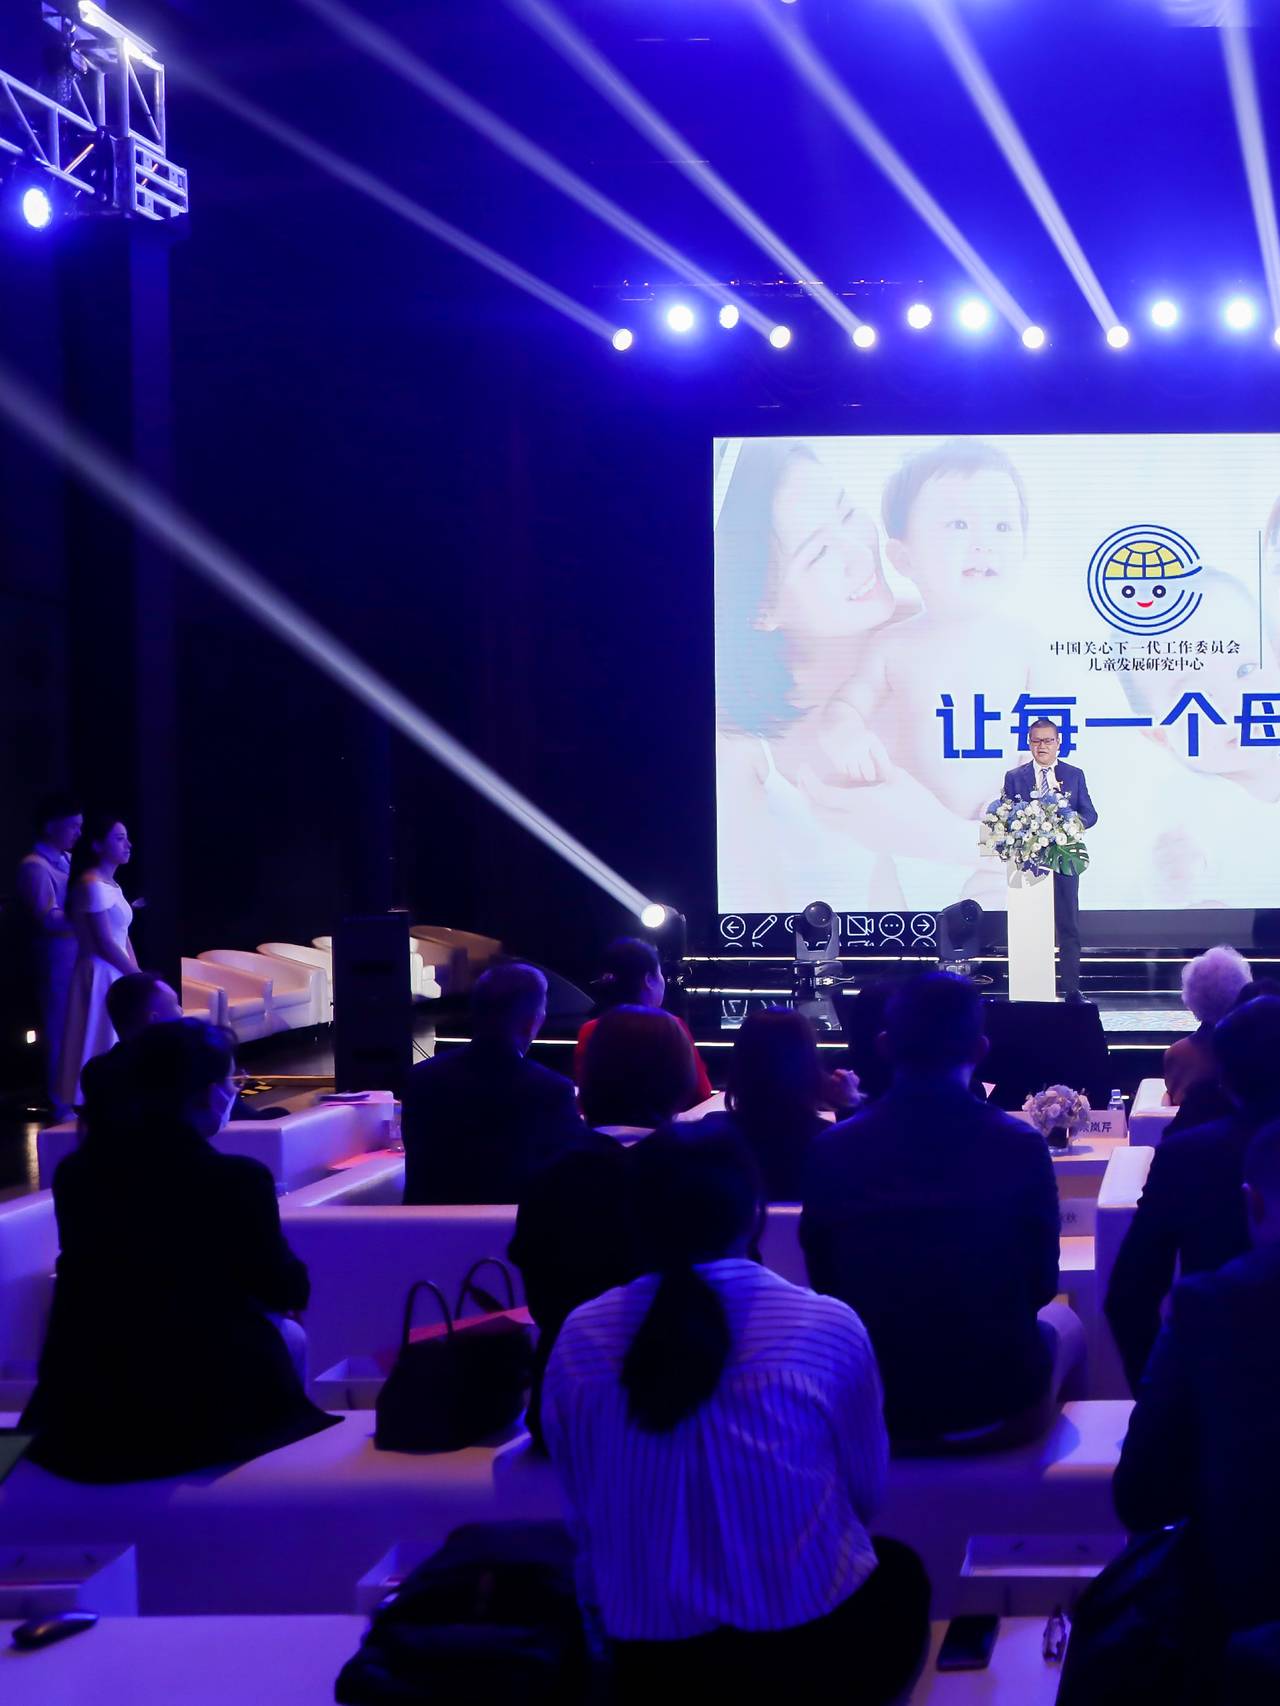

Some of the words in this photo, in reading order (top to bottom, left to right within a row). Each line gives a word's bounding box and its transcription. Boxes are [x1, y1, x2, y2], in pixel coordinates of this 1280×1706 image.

[1050, 640, 1241, 655] 中国关心下一代工作委员会
[1088, 656, 1204, 672] 儿童发展研究中心
